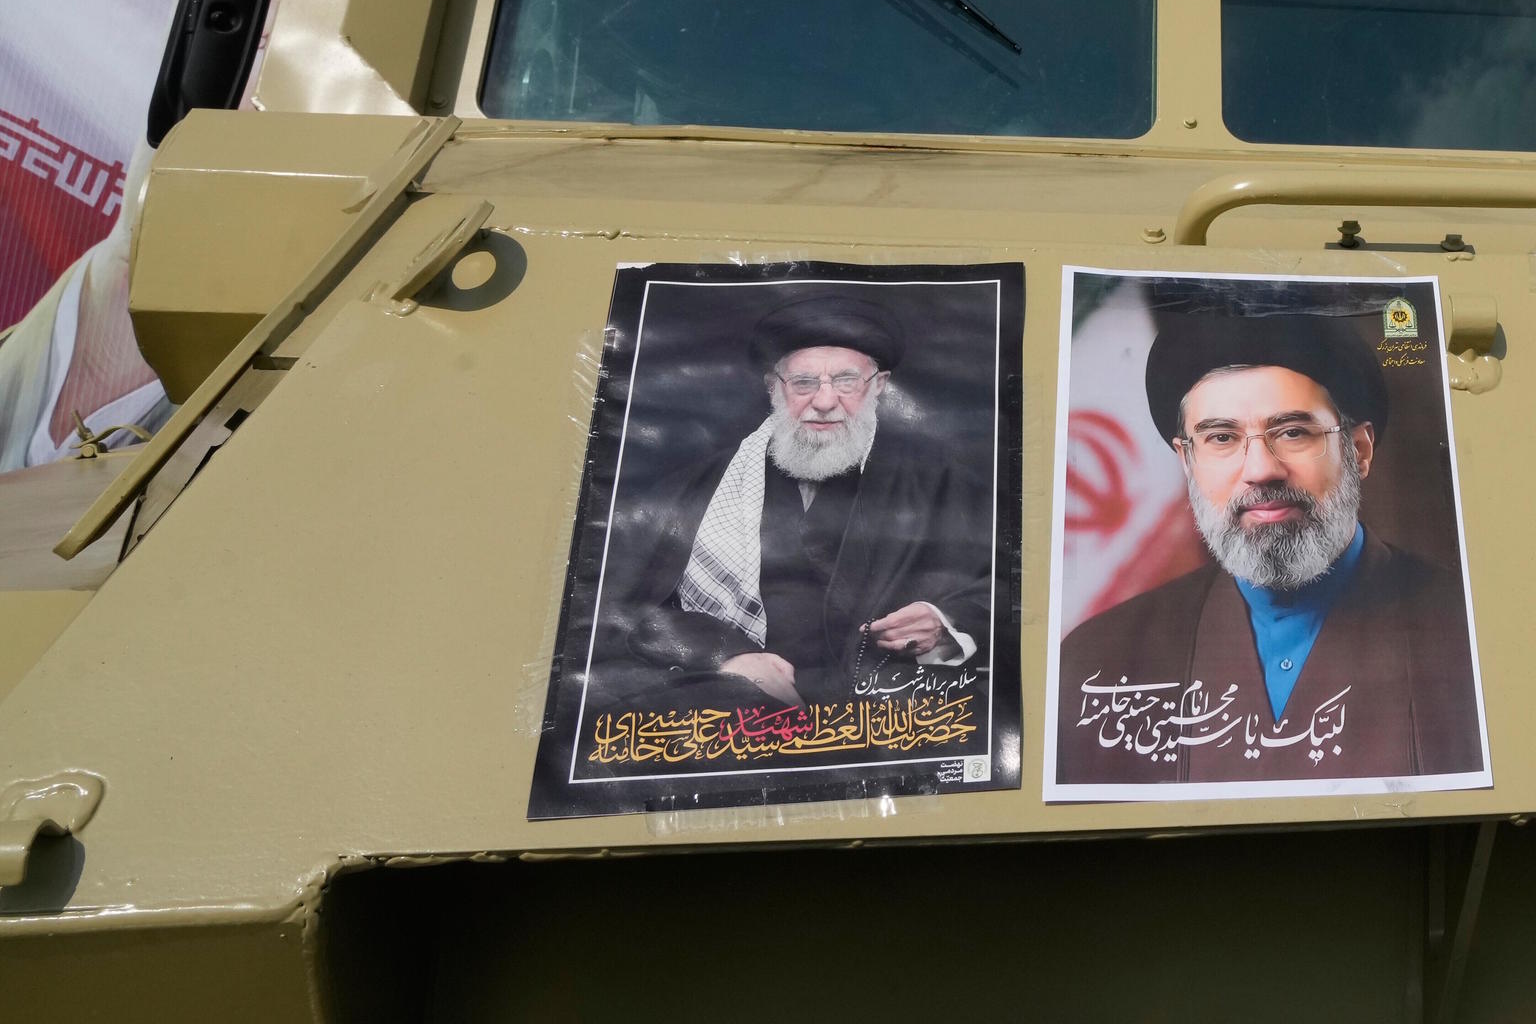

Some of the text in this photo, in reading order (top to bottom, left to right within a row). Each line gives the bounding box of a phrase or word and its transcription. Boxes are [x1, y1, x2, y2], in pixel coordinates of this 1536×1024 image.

[854, 666, 977, 709] سلام بر امام شهیدان
[1180, 679, 1209, 733] امام
[718, 704, 815, 743] شهید
[900, 695, 977, 751] حضرت
[1159, 714, 1242, 762] سید
[1245, 713, 1260, 759] یا
[1260, 685, 1351, 766] لبیک
